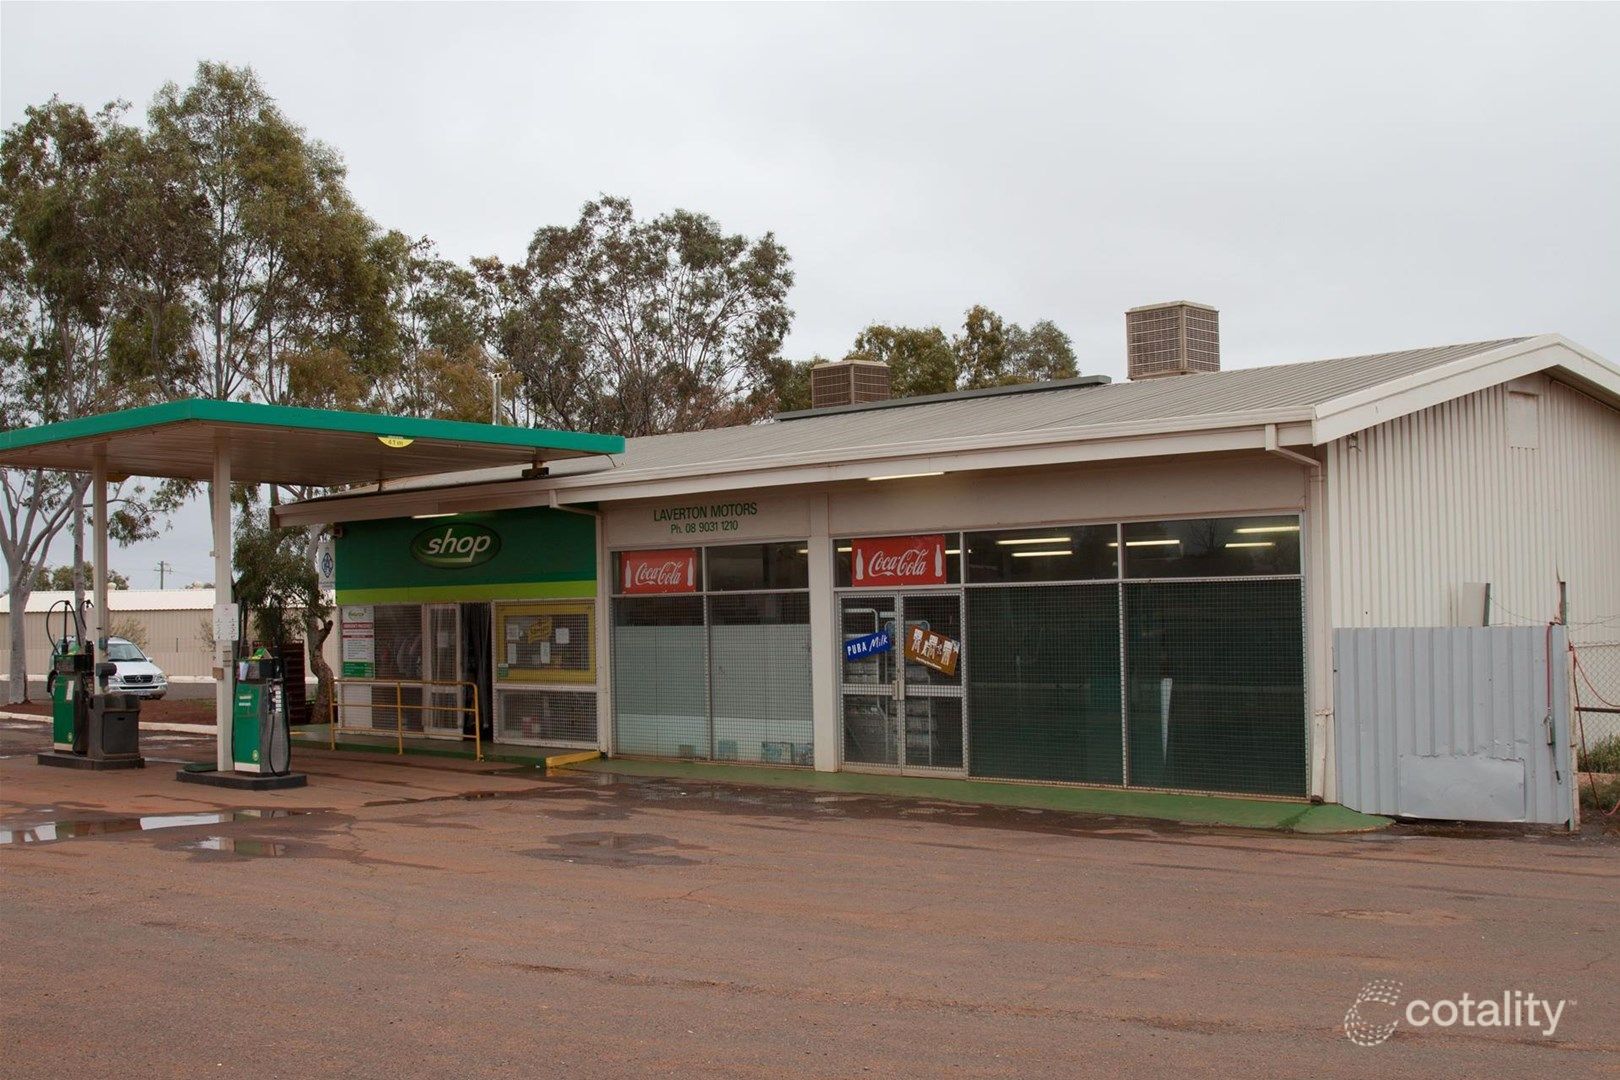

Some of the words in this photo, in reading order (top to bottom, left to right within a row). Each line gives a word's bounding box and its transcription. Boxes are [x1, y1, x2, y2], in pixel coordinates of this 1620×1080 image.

[654, 508, 707, 522] LAVERTON
[711, 504, 758, 517] MOTORS
[687, 524, 696, 533] 08
[700, 522, 718, 532] 9031
[722, 521, 739, 531] 1210
[427, 528, 491, 562] shop
[868, 550, 928, 577] Coca-Cola
[868, 634, 888, 652] Milk
